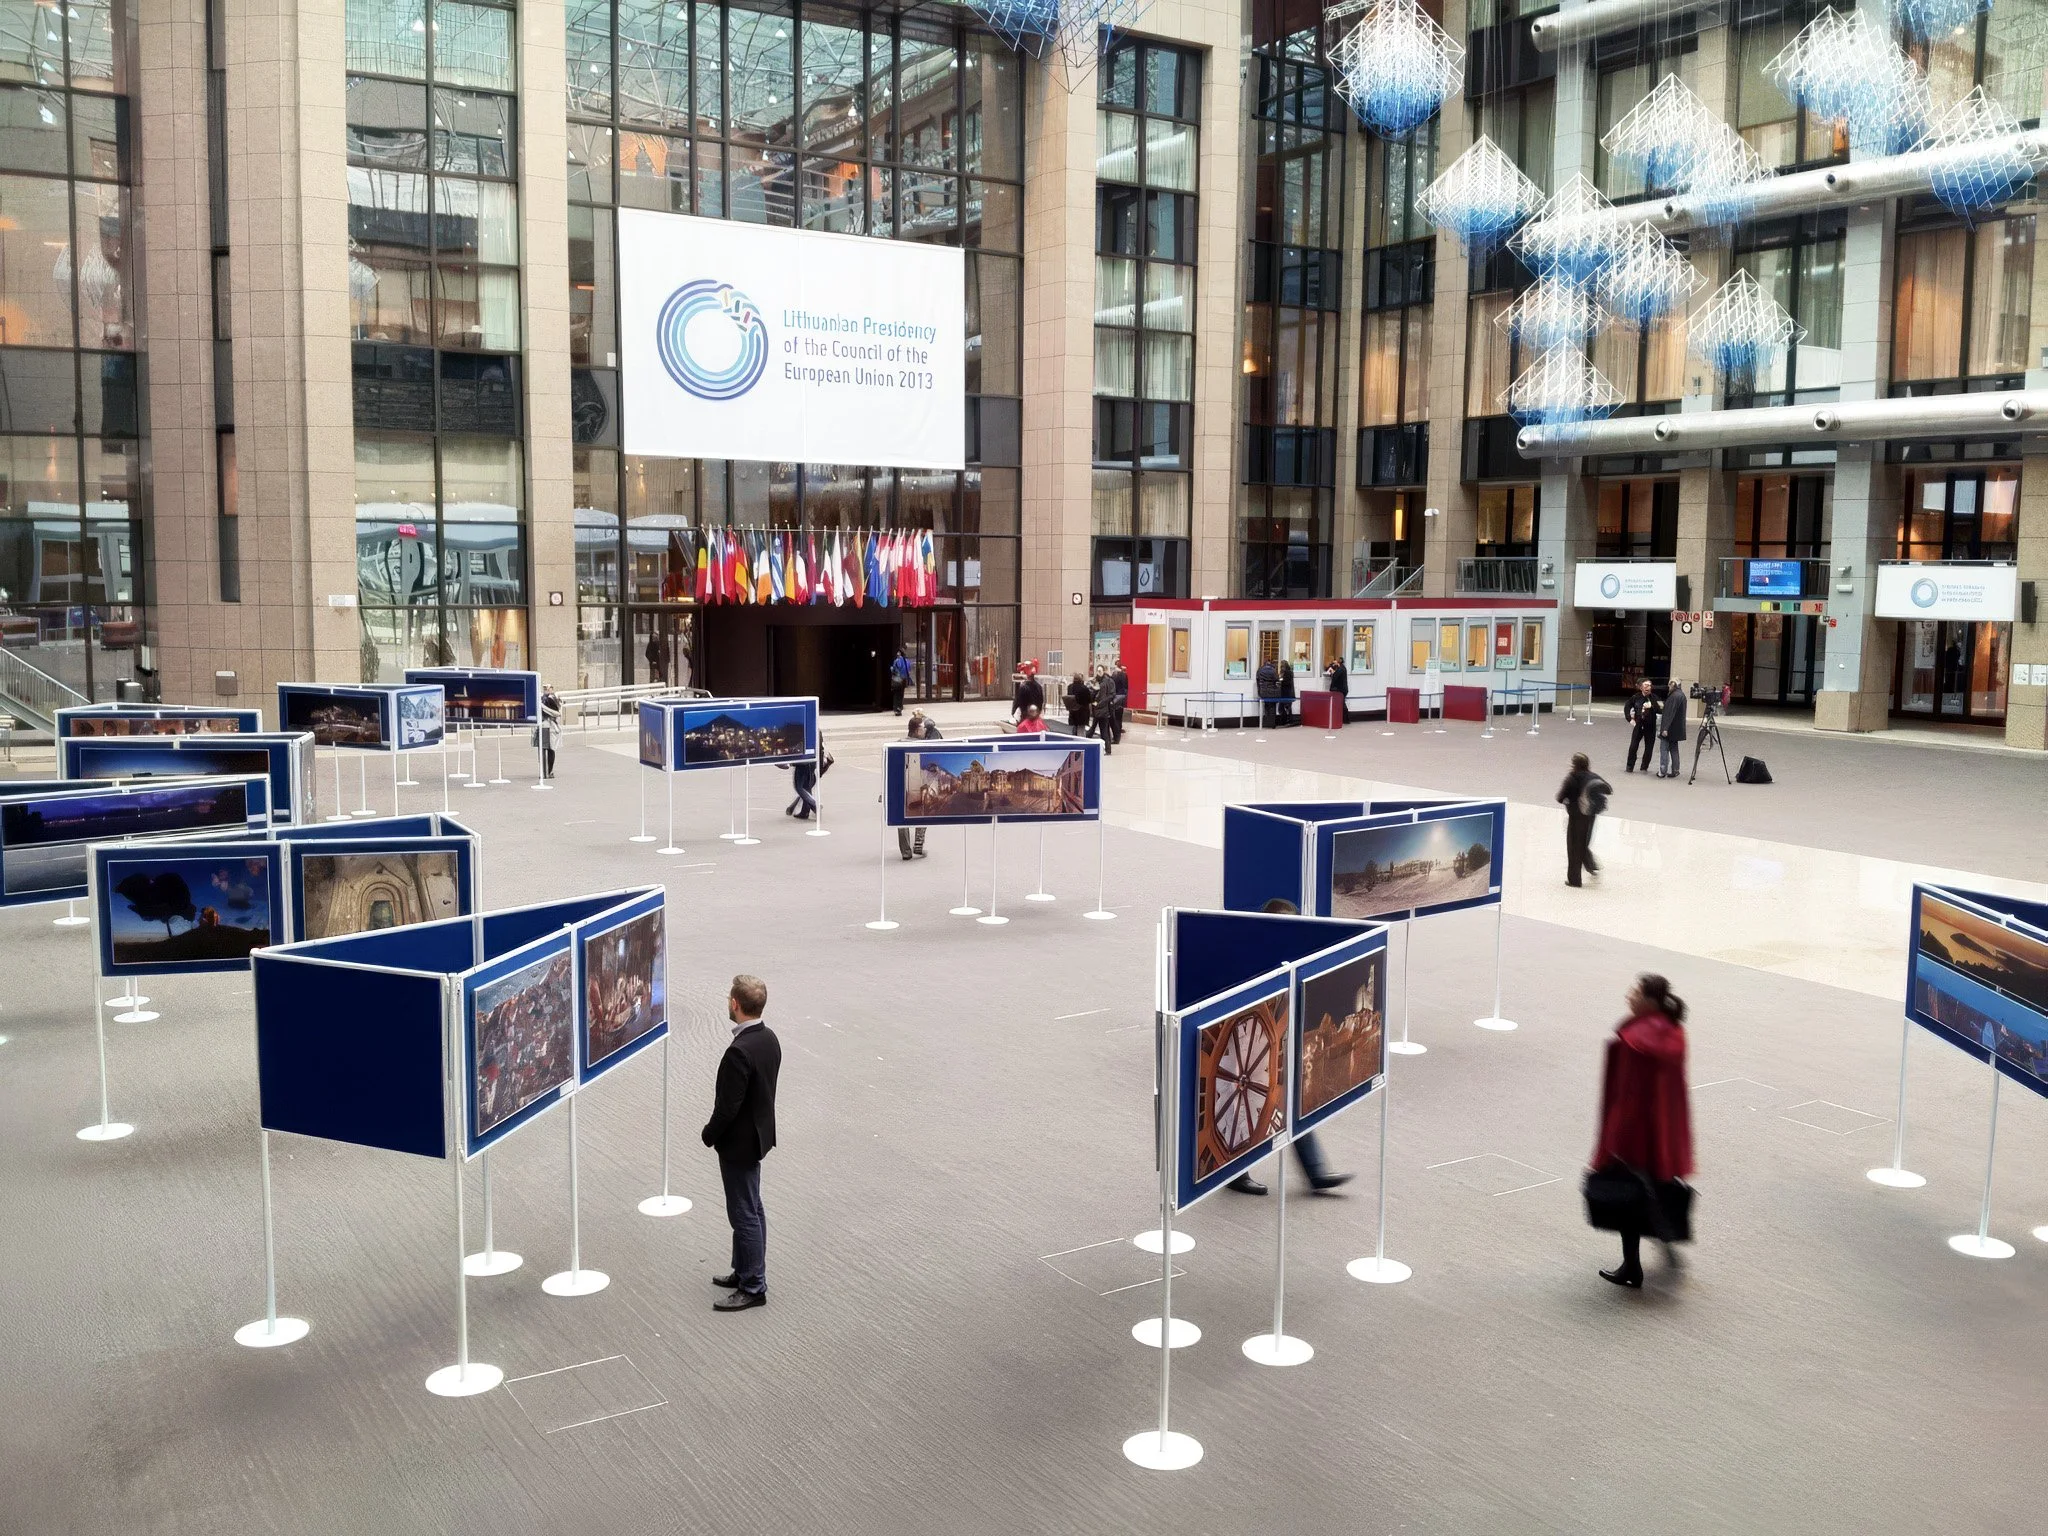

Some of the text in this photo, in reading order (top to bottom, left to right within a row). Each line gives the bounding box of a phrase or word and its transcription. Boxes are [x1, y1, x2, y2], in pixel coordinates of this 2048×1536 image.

[784, 310, 937, 344] Lithuanian Presidency
[784, 336, 928, 365] of the Council of the
[785, 362, 933, 390] European Union 2013
